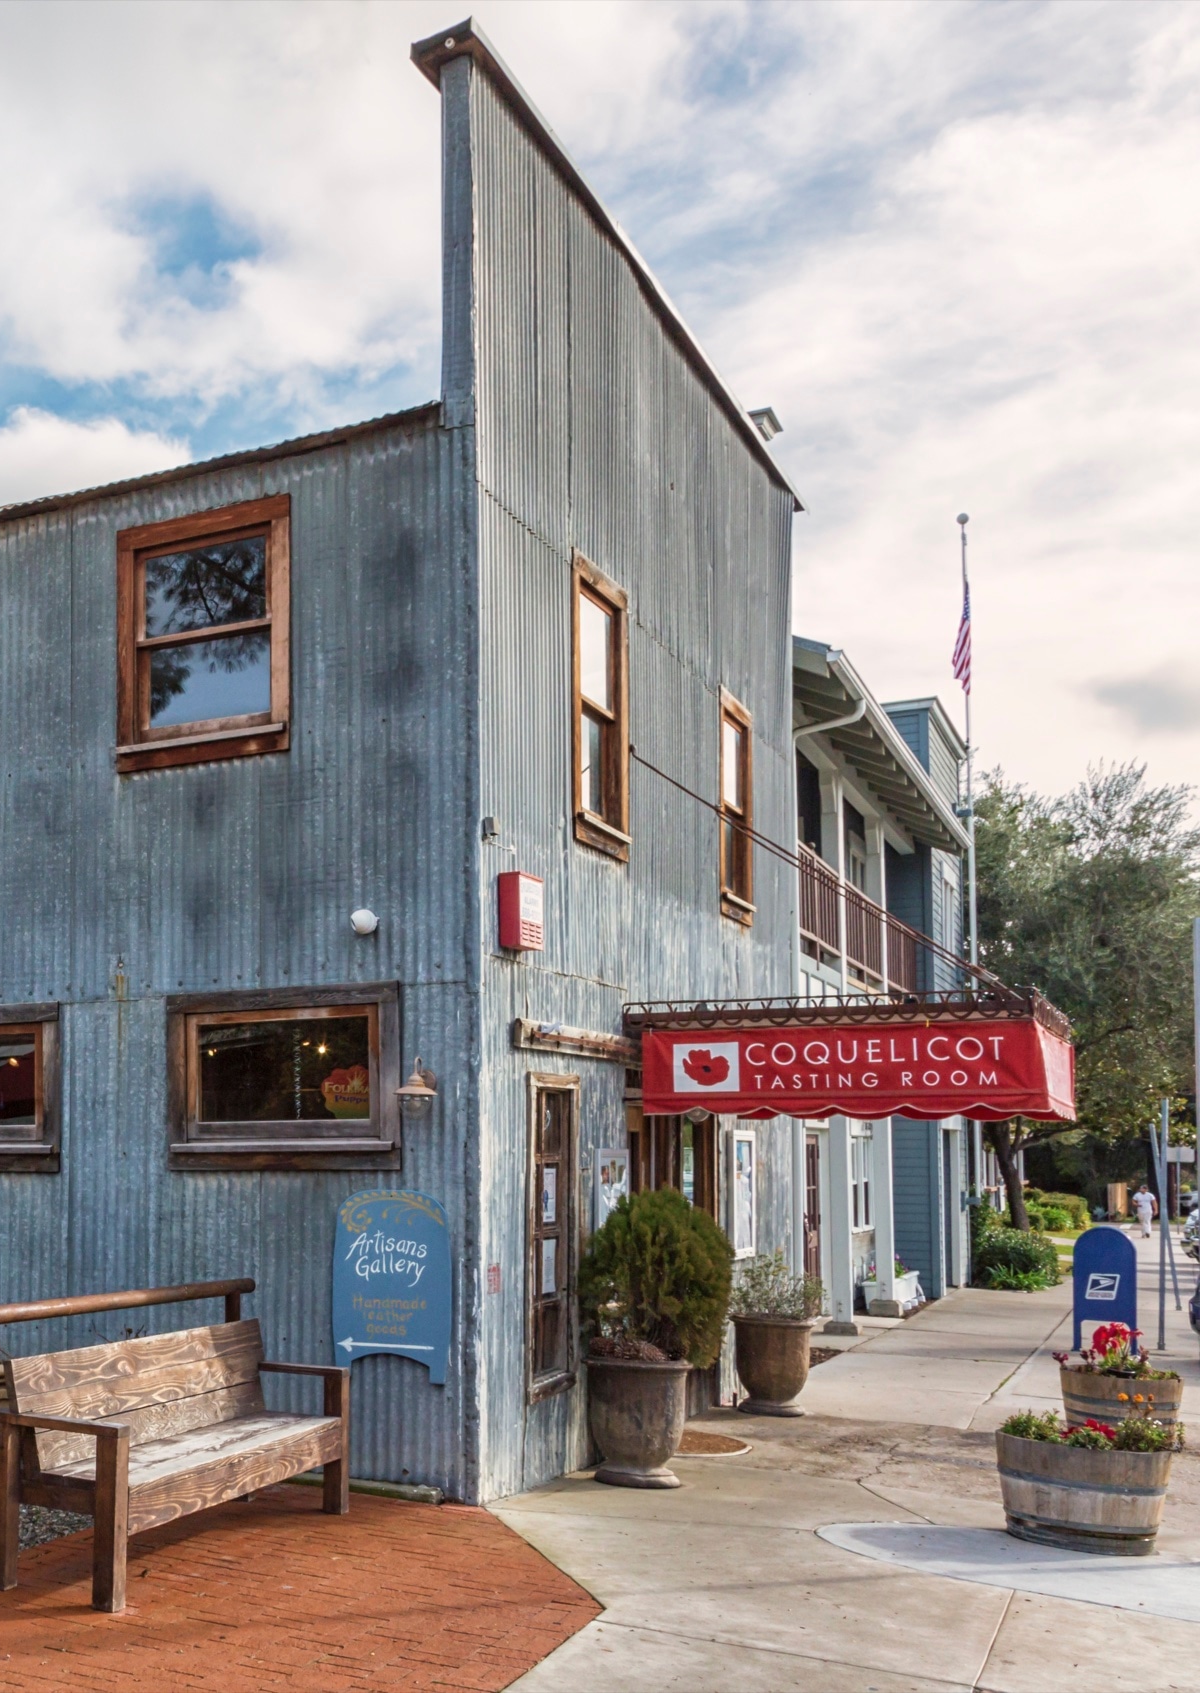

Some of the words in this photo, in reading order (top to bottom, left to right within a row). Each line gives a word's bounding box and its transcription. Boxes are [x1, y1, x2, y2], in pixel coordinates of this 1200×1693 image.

[744, 1035, 1005, 1066] COQUELICOT
[753, 1071, 880, 1090] TASTING
[901, 1069, 999, 1087] ROOM
[345, 1229, 428, 1259] Artisans
[355, 1253, 426, 1288] Gallery
